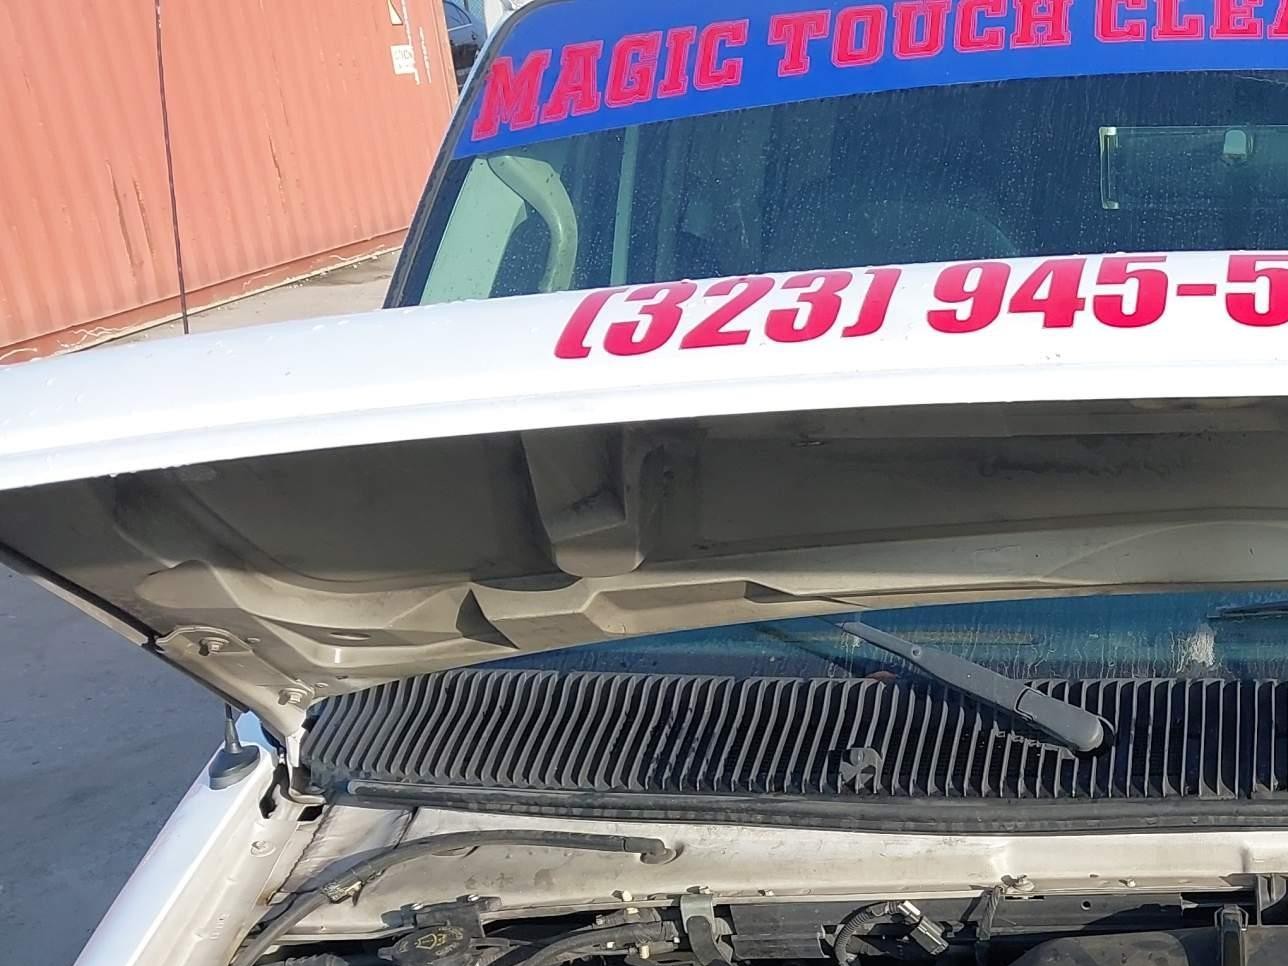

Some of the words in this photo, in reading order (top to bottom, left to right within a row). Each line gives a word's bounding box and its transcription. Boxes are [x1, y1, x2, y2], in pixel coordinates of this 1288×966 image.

[471, 19, 749, 141] MAGIC
[767, 0, 1074, 77] TOUCH
[553, 262, 902, 360] (323)
